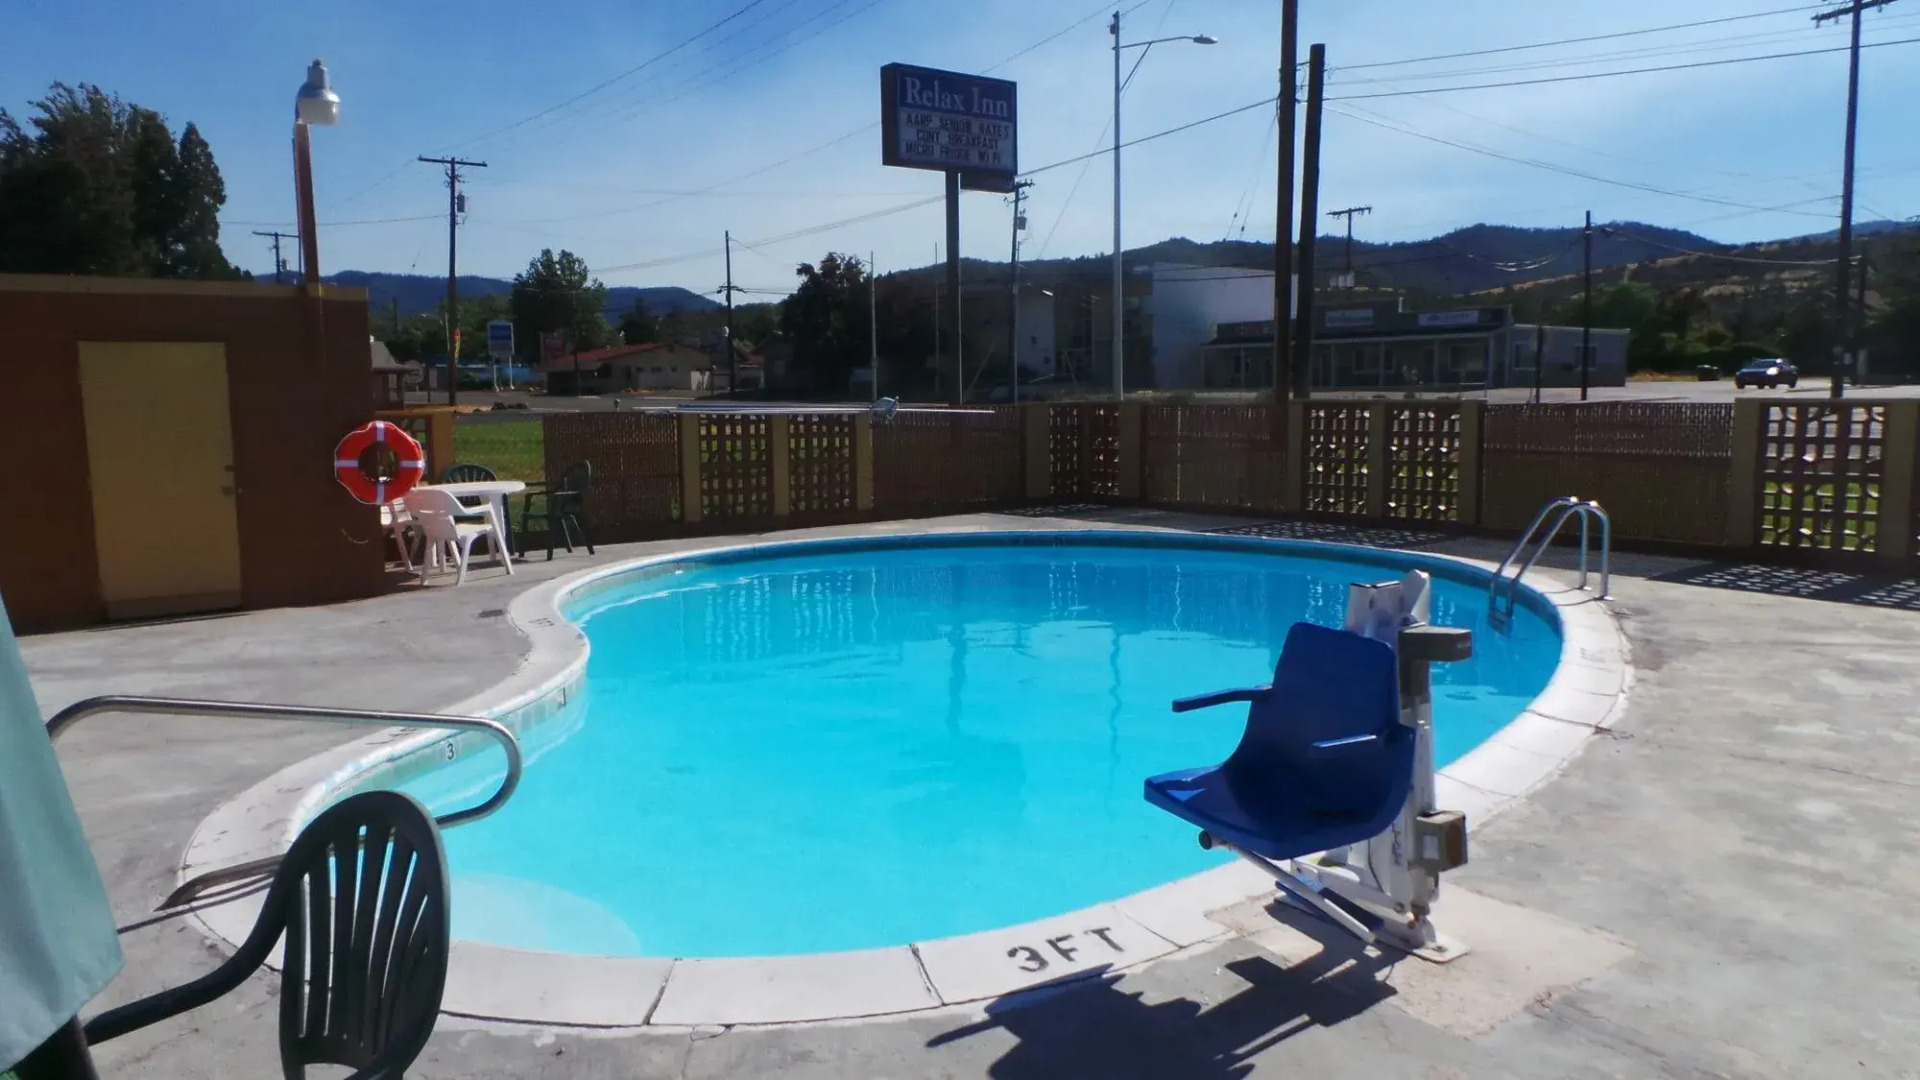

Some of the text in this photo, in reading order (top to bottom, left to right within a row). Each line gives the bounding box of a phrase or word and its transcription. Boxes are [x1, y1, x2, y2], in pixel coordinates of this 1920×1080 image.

[905, 77, 1008, 116] Relax Inn
[907, 113, 1009, 138] AARP SENIOR RATES
[905, 142, 934, 156] MICRO
[940, 146, 970, 161] FRIDGE
[948, 133, 999, 150] BREAKFAST
[1007, 926, 1125, 972] 3FT
